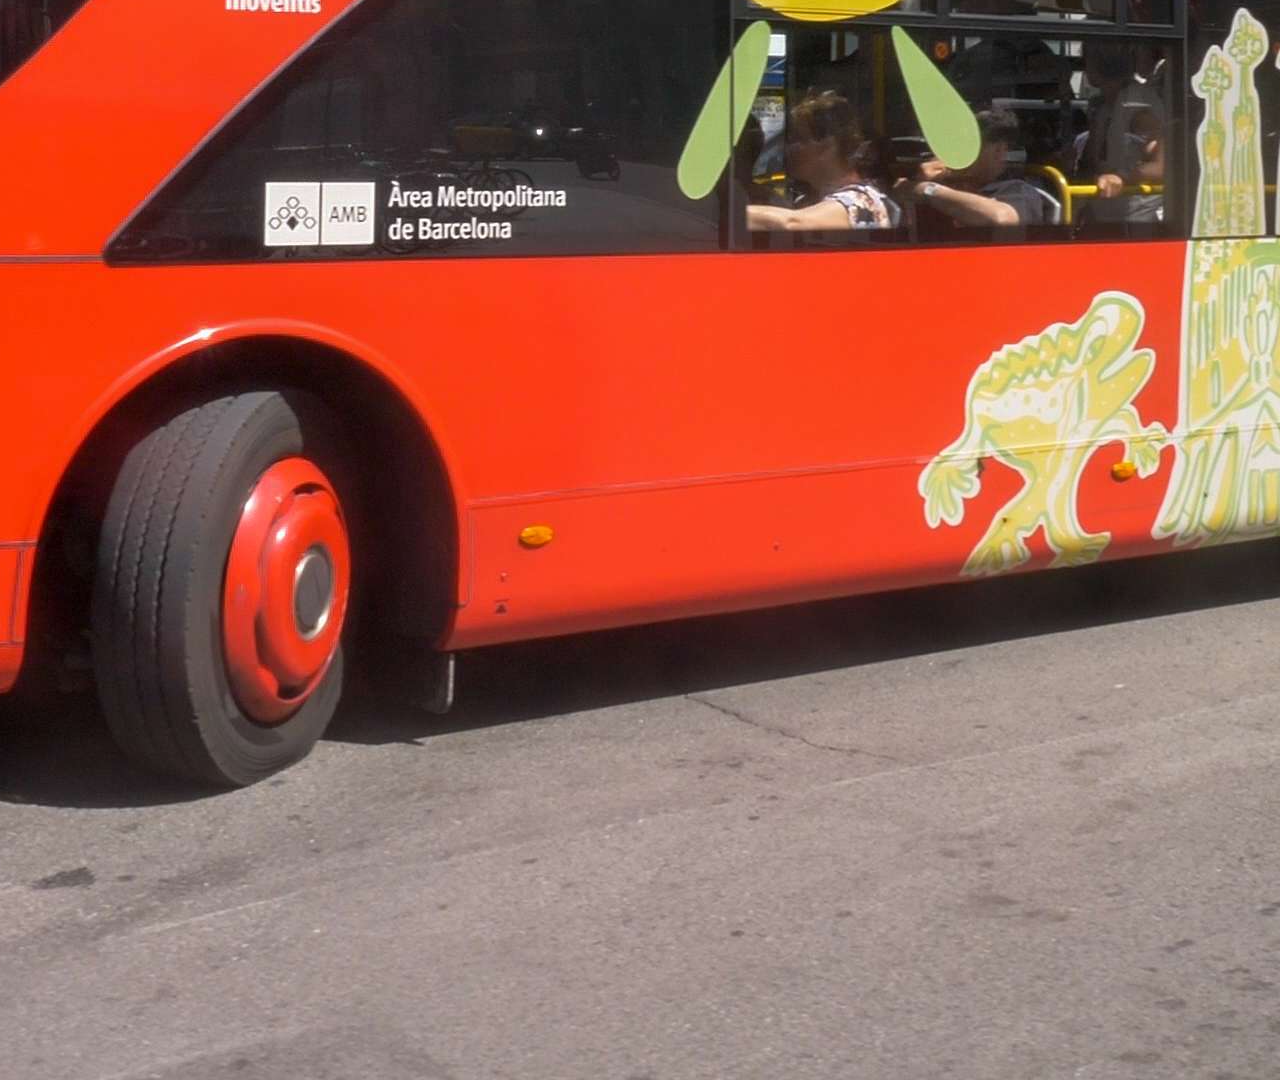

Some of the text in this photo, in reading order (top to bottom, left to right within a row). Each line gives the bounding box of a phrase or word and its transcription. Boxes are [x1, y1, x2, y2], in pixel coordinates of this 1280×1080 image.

[437, 185, 567, 212] Metropolitana
[328, 206, 367, 224] AMB
[388, 219, 512, 240] de Barcelona
